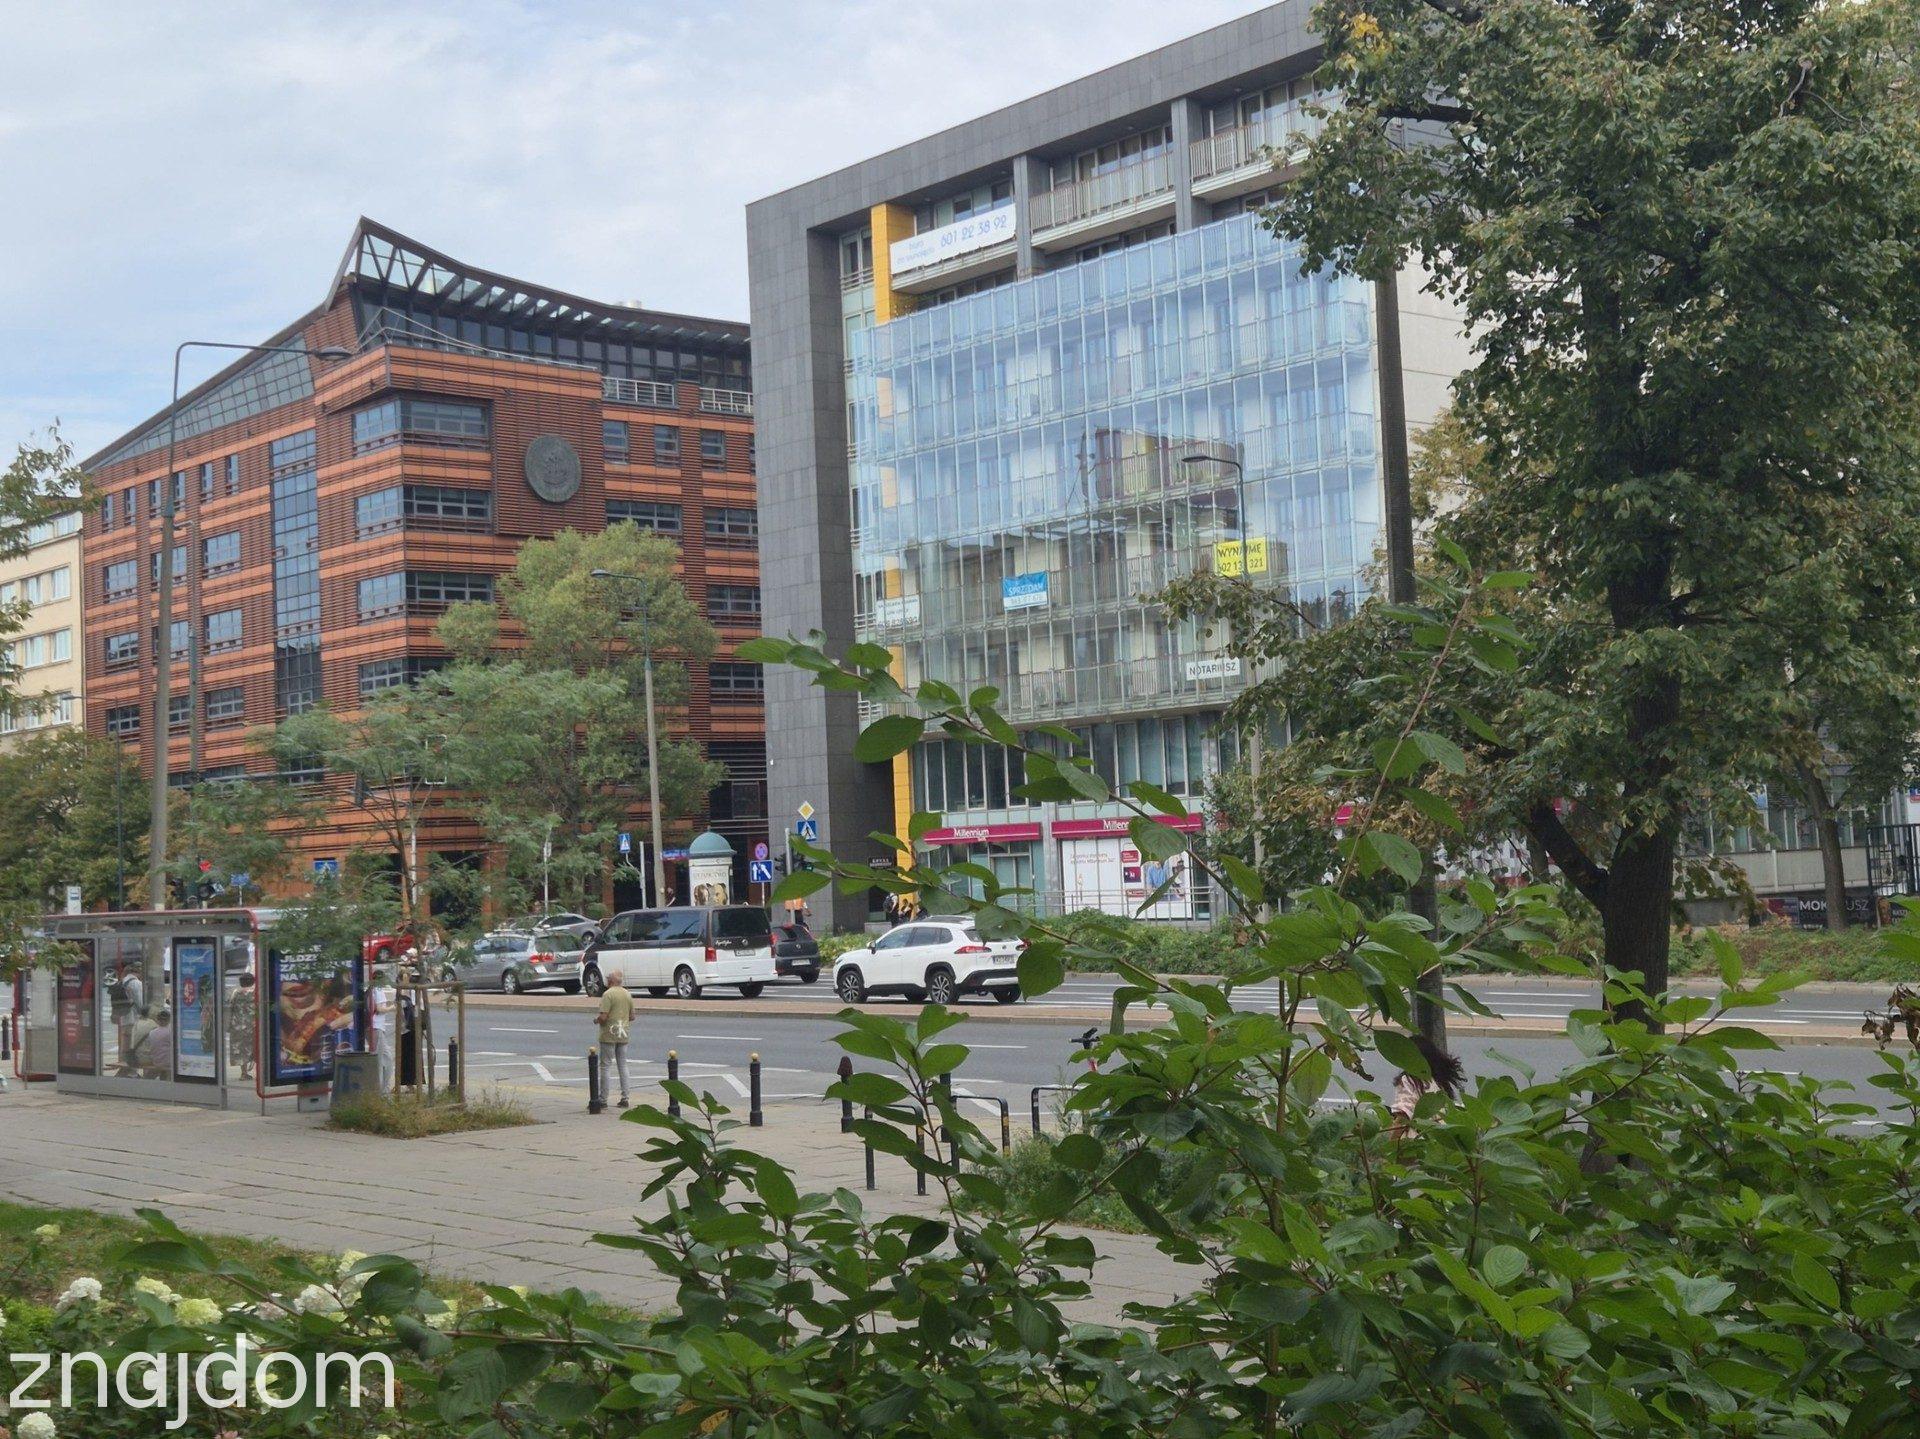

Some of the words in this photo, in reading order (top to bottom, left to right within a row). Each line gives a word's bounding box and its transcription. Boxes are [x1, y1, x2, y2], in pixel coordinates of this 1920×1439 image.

[941, 232, 957, 248] 601
[1249, 557, 1264, 569] 321
[953, 827, 990, 838] Millennium
